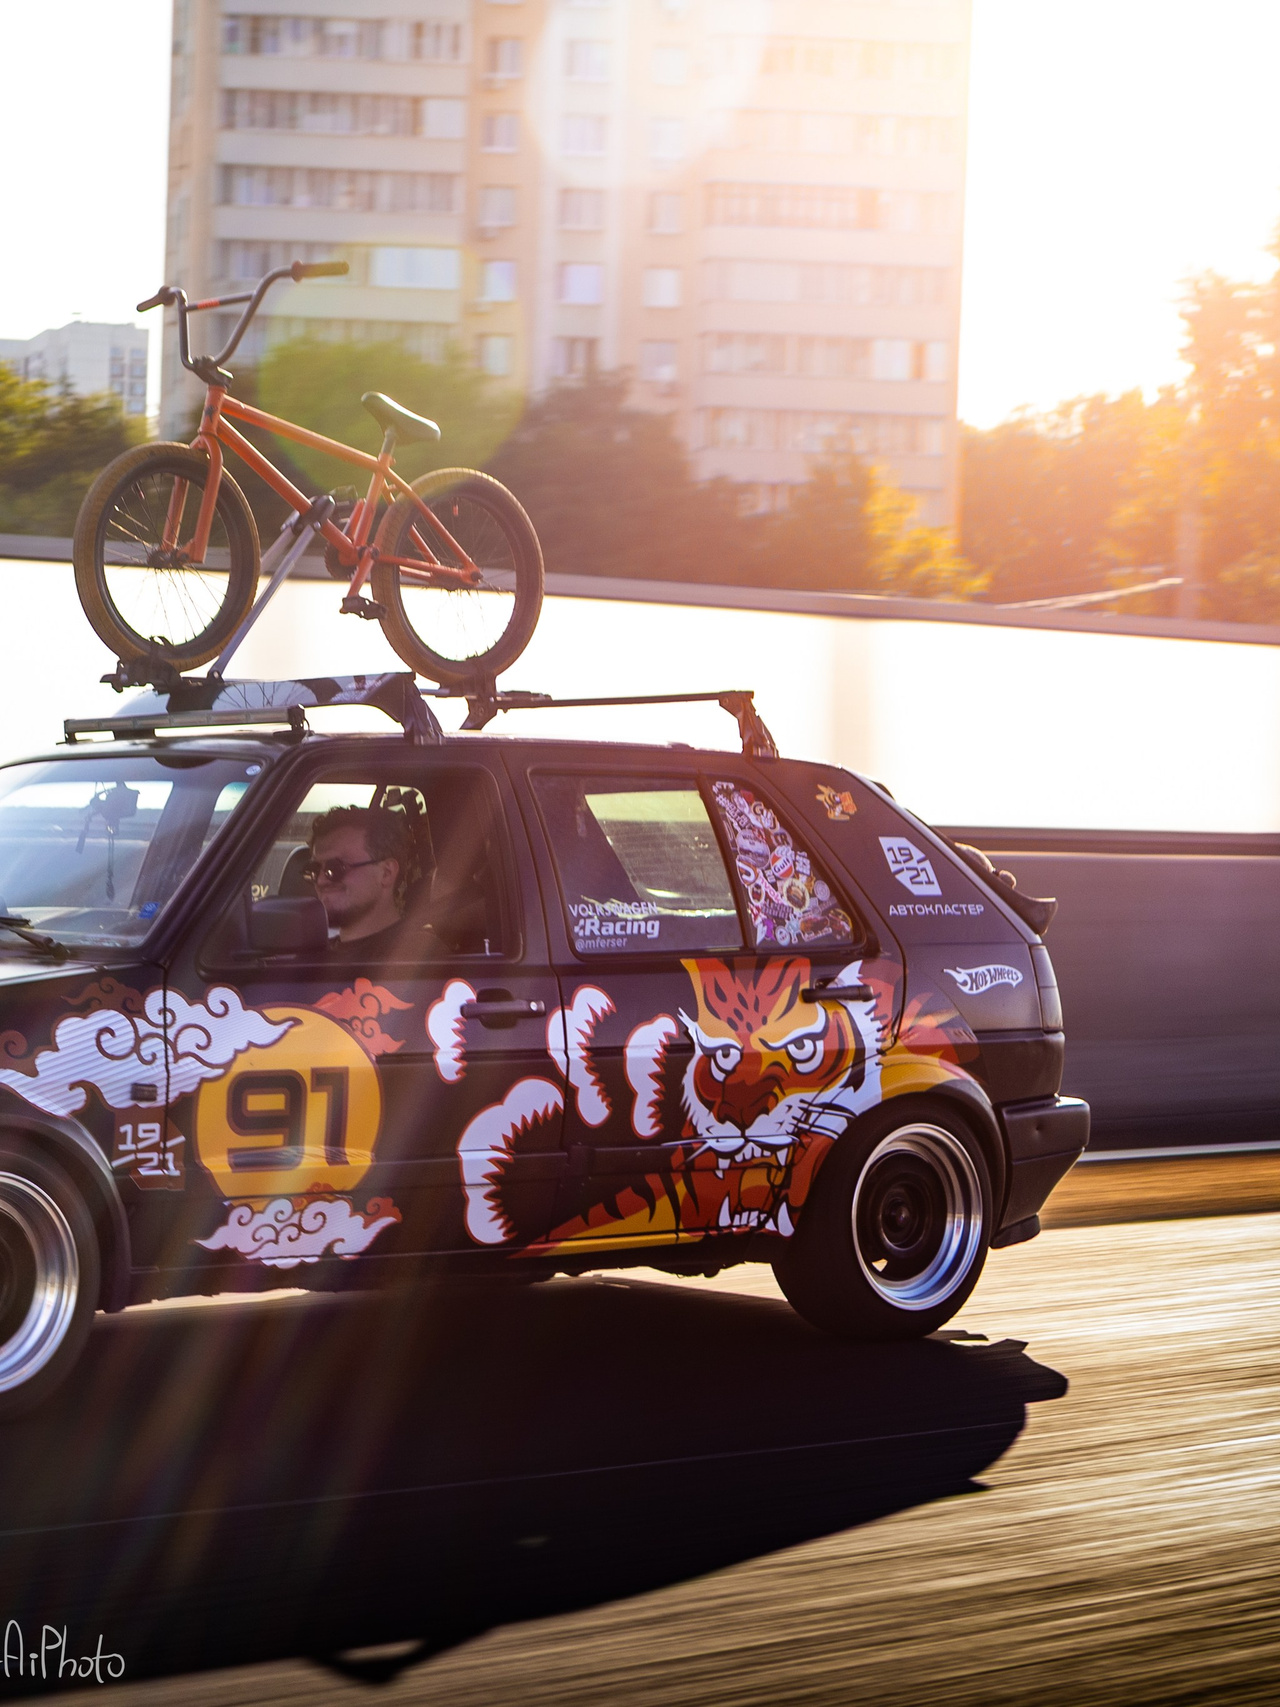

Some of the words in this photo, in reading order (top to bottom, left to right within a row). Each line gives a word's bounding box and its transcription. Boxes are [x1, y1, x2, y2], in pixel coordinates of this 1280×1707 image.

[569, 902, 658, 917] VOLKSWAGEN
[584, 917, 660, 939] Racing
[226, 1066, 350, 1173] 91
